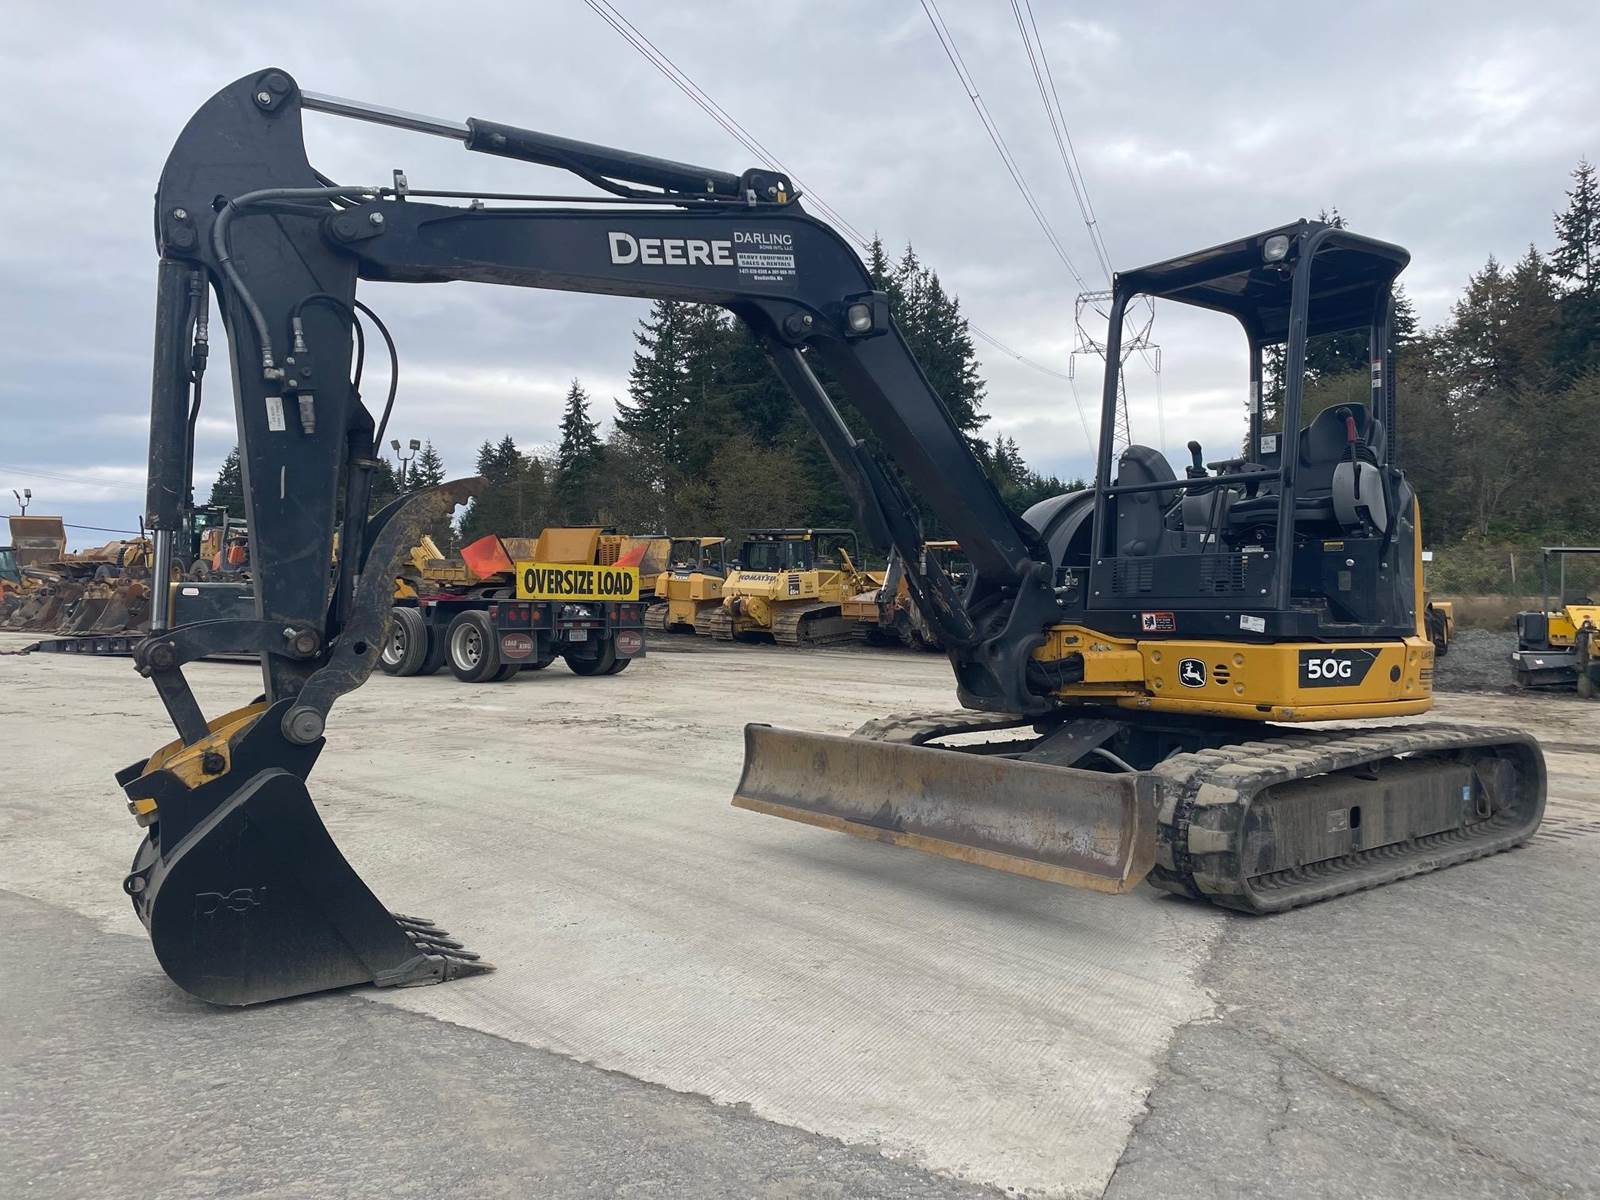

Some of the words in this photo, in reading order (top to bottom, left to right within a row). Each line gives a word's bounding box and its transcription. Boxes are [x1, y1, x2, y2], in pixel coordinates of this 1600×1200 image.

[608, 231, 734, 265] DEERE
[734, 231, 792, 245] DARLING
[524, 568, 594, 595] OVERSIZE
[597, 571, 633, 595] LOAD
[739, 574, 776, 582] KOMATSU
[1308, 658, 1351, 679] 50G
